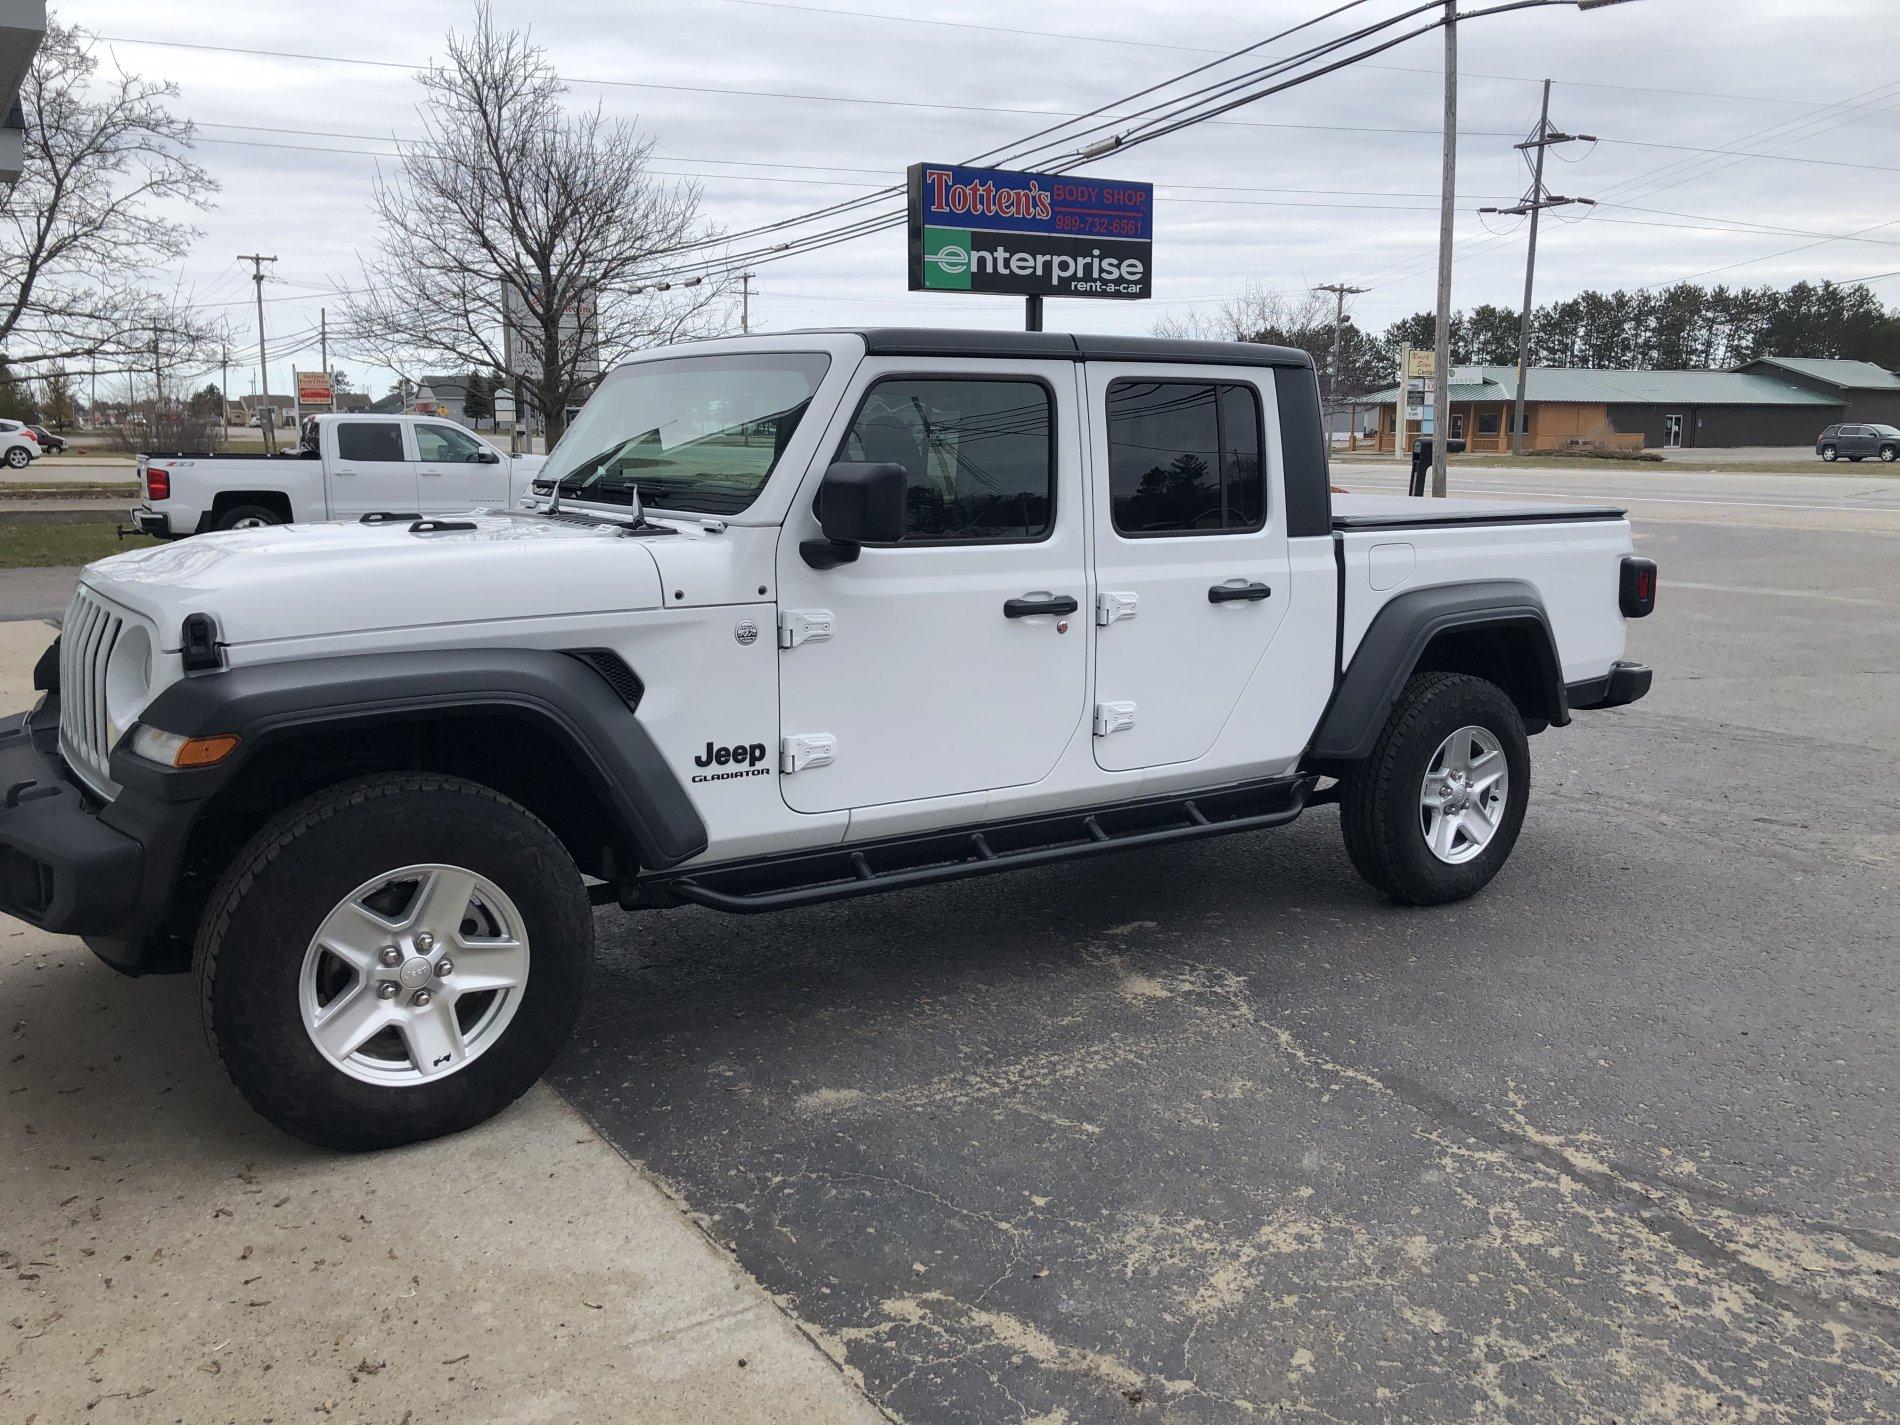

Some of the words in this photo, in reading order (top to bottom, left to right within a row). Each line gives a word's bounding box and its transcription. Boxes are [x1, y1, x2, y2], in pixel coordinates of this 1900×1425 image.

[927, 170, 1052, 220] Totten's
[1053, 185, 1098, 203] BODY
[1103, 189, 1146, 206] SHOP
[1055, 215, 1144, 235] 989-732-6561
[925, 245, 1144, 286] enterprise
[1071, 281, 1143, 294] rent-a-car
[694, 741, 766, 768] Jeep
[691, 768, 771, 783] GLADIATOR
